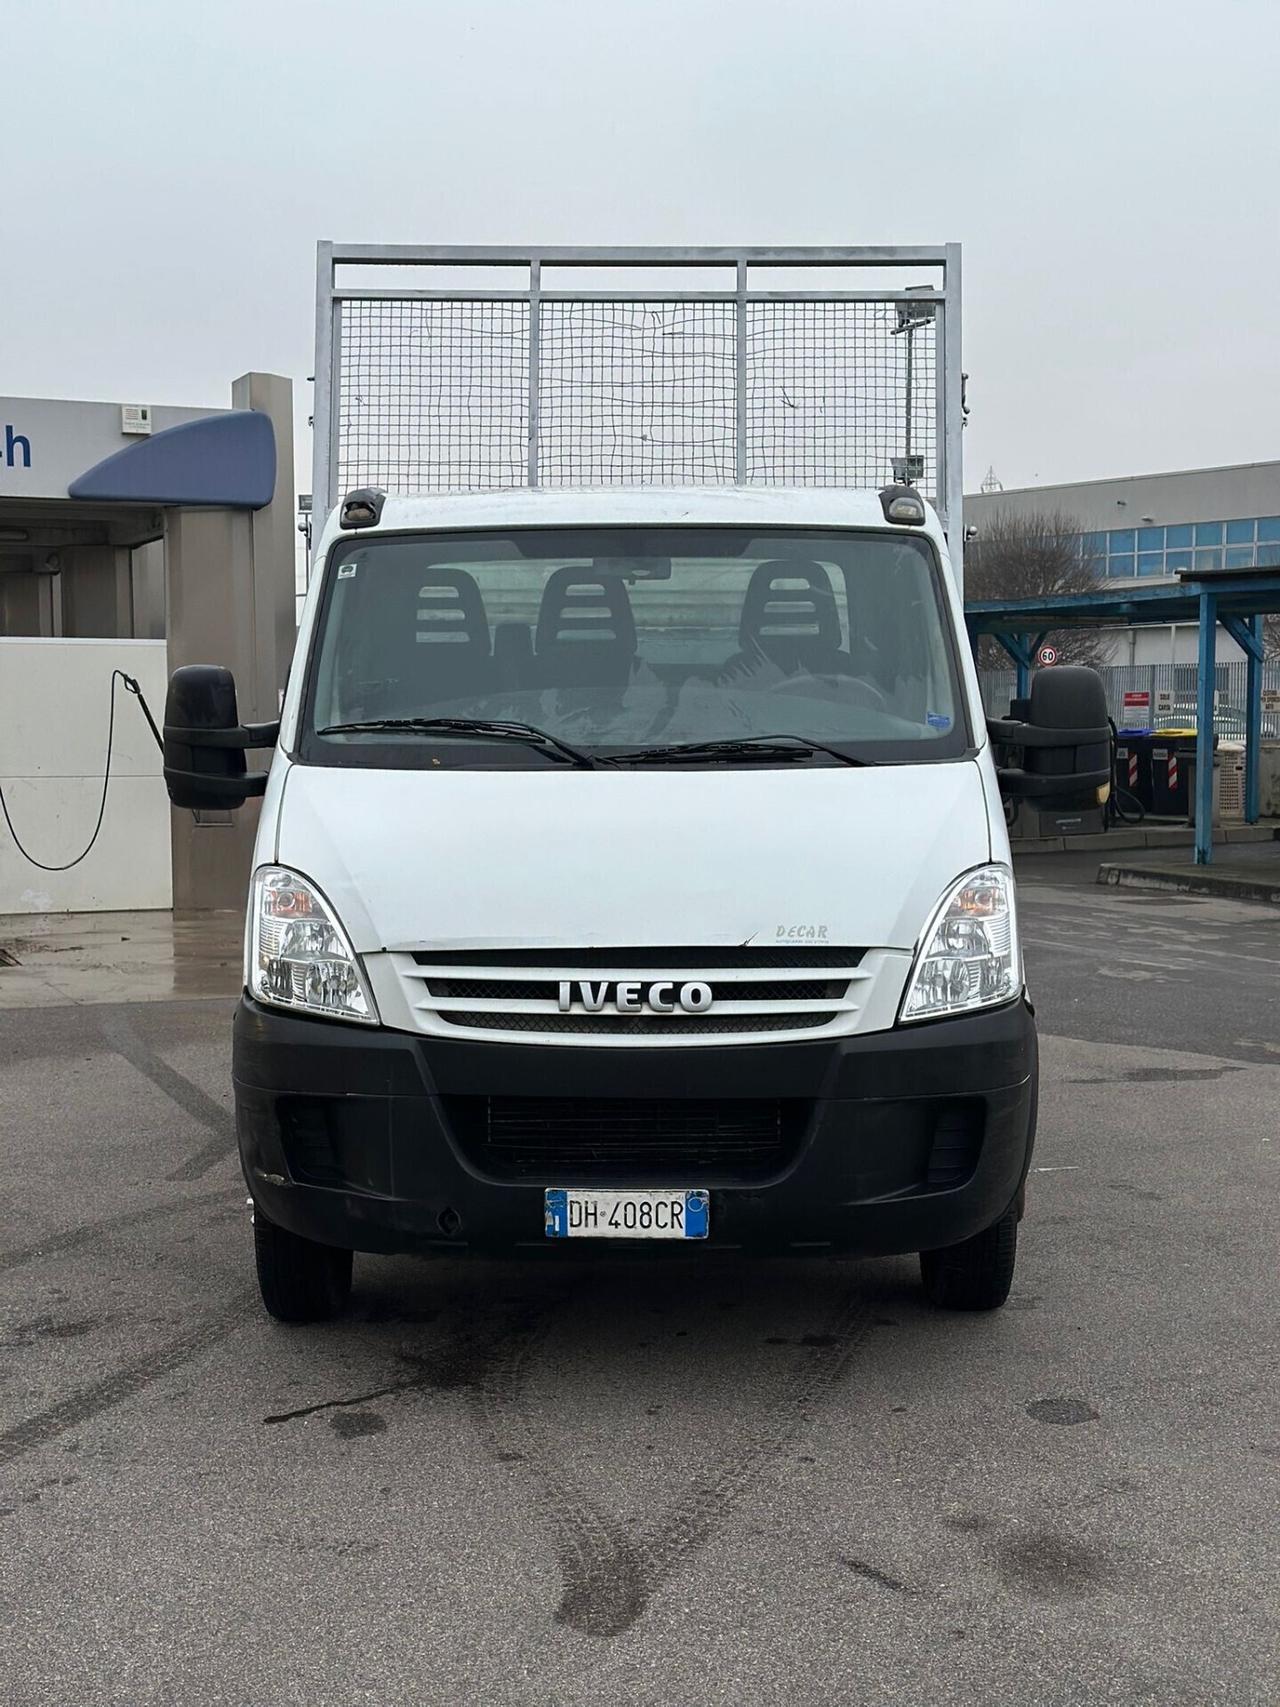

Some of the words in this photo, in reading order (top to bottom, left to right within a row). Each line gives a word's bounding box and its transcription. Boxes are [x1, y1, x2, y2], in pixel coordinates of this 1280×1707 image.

[0, 425, 31, 467] h
[1042, 651, 1054, 661] 60
[775, 925, 828, 938] DECAR
[558, 981, 713, 1013] IVECO
[569, 1200, 598, 1229] DH
[608, 1201, 684, 1230] 408CR
